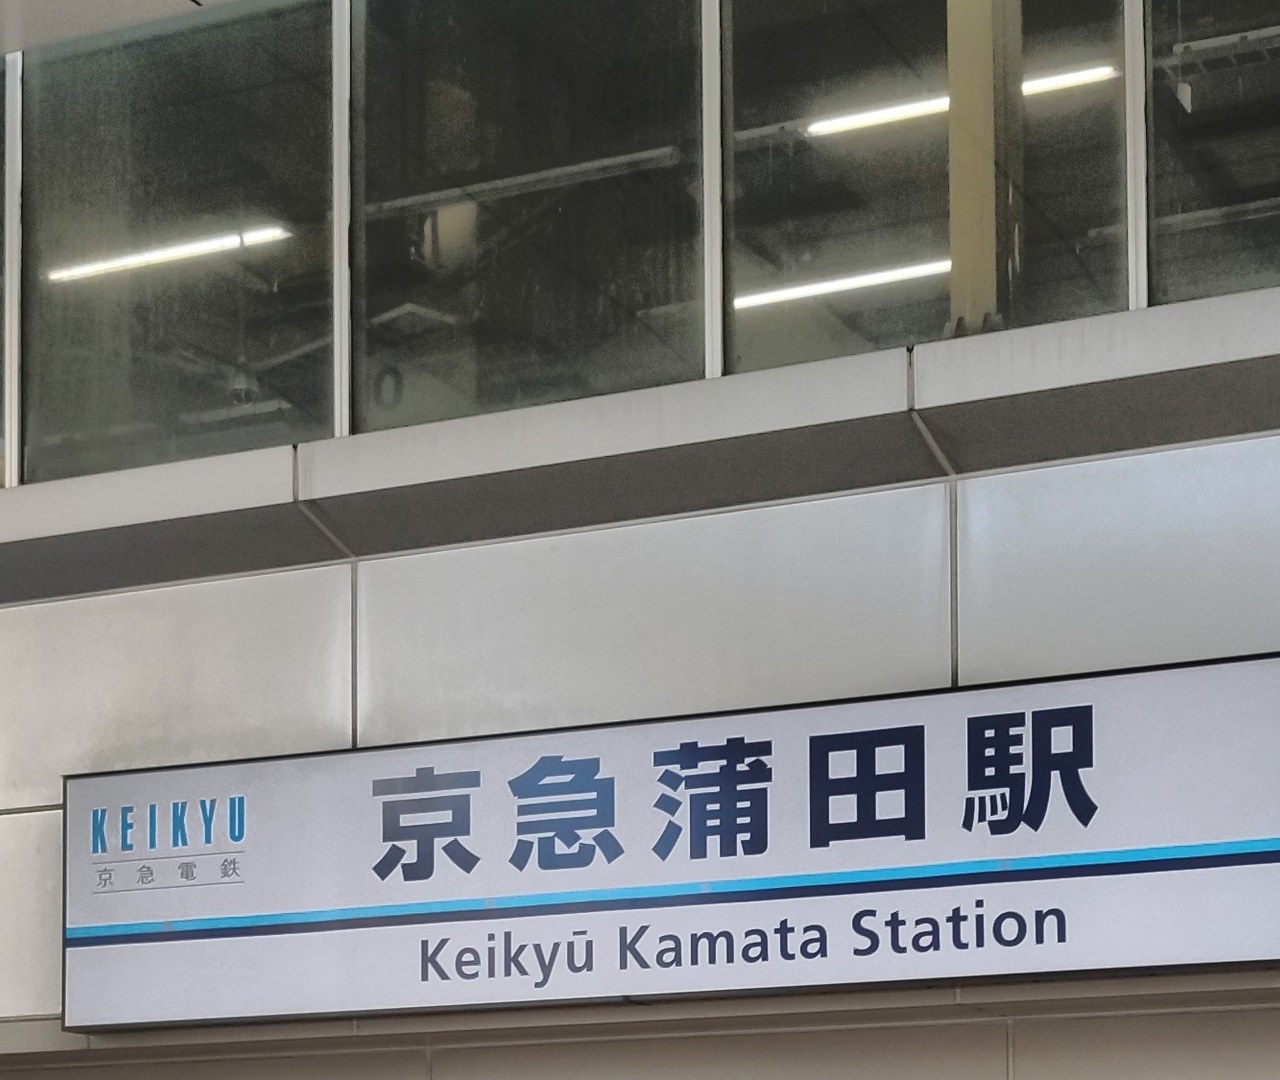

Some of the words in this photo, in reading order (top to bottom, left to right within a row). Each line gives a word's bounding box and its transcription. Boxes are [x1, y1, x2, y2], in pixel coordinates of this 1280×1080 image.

[91, 796, 246, 854] KEIKYU
[372, 705, 1099, 882] 京急蒲田駅
[97, 858, 241, 888] 京急電鉄
[420, 929, 594, 989] Keikyū
[619, 919, 828, 971] Kamata
[851, 899, 1067, 957] Station
